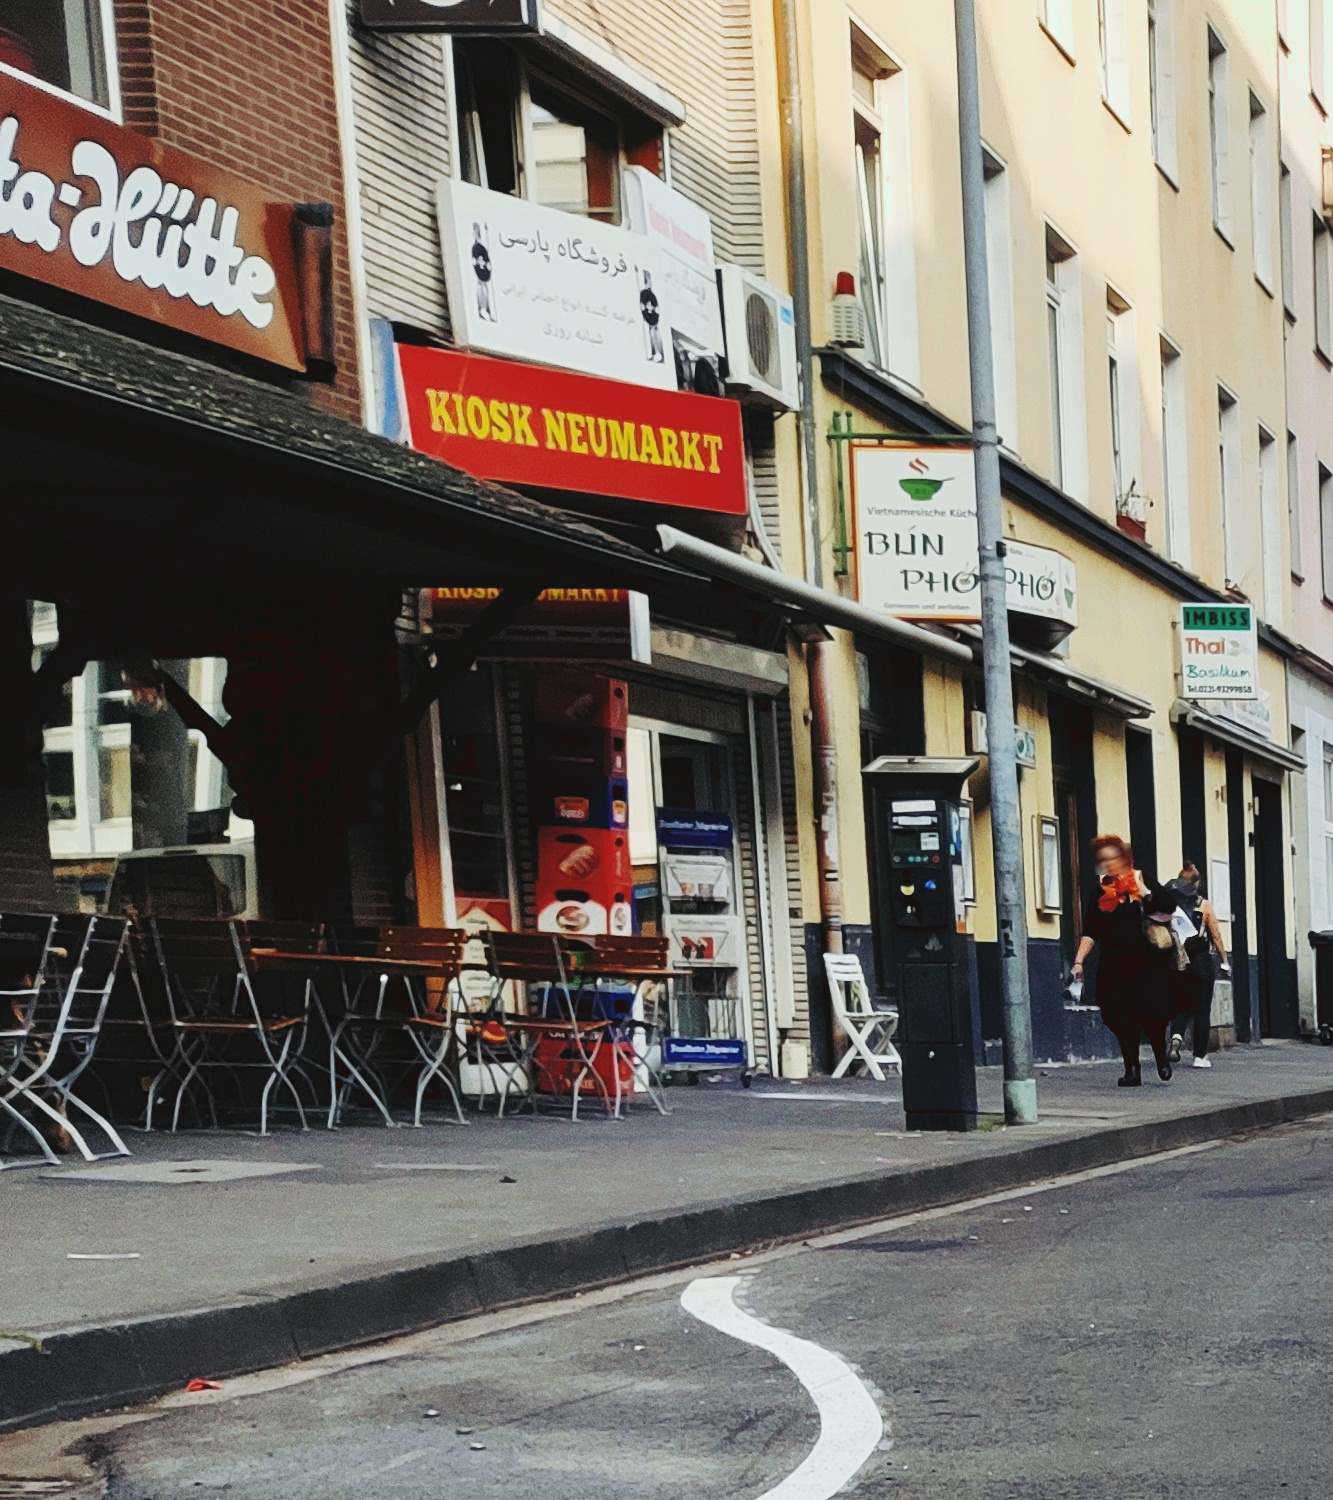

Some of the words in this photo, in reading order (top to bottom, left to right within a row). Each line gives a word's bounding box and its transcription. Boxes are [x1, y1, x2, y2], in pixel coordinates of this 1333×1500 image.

[498, 229, 551, 264] پارسی
[557, 237, 628, 278] فروشگاه
[424, 388, 540, 448] KIOSK
[541, 408, 724, 475] NEUMARKT
[866, 506, 946, 518] Vietnamesische
[949, 508, 978, 519] Küch
[1183, 610, 1249, 626] IMBISS
[1185, 637, 1226, 655] Thai
